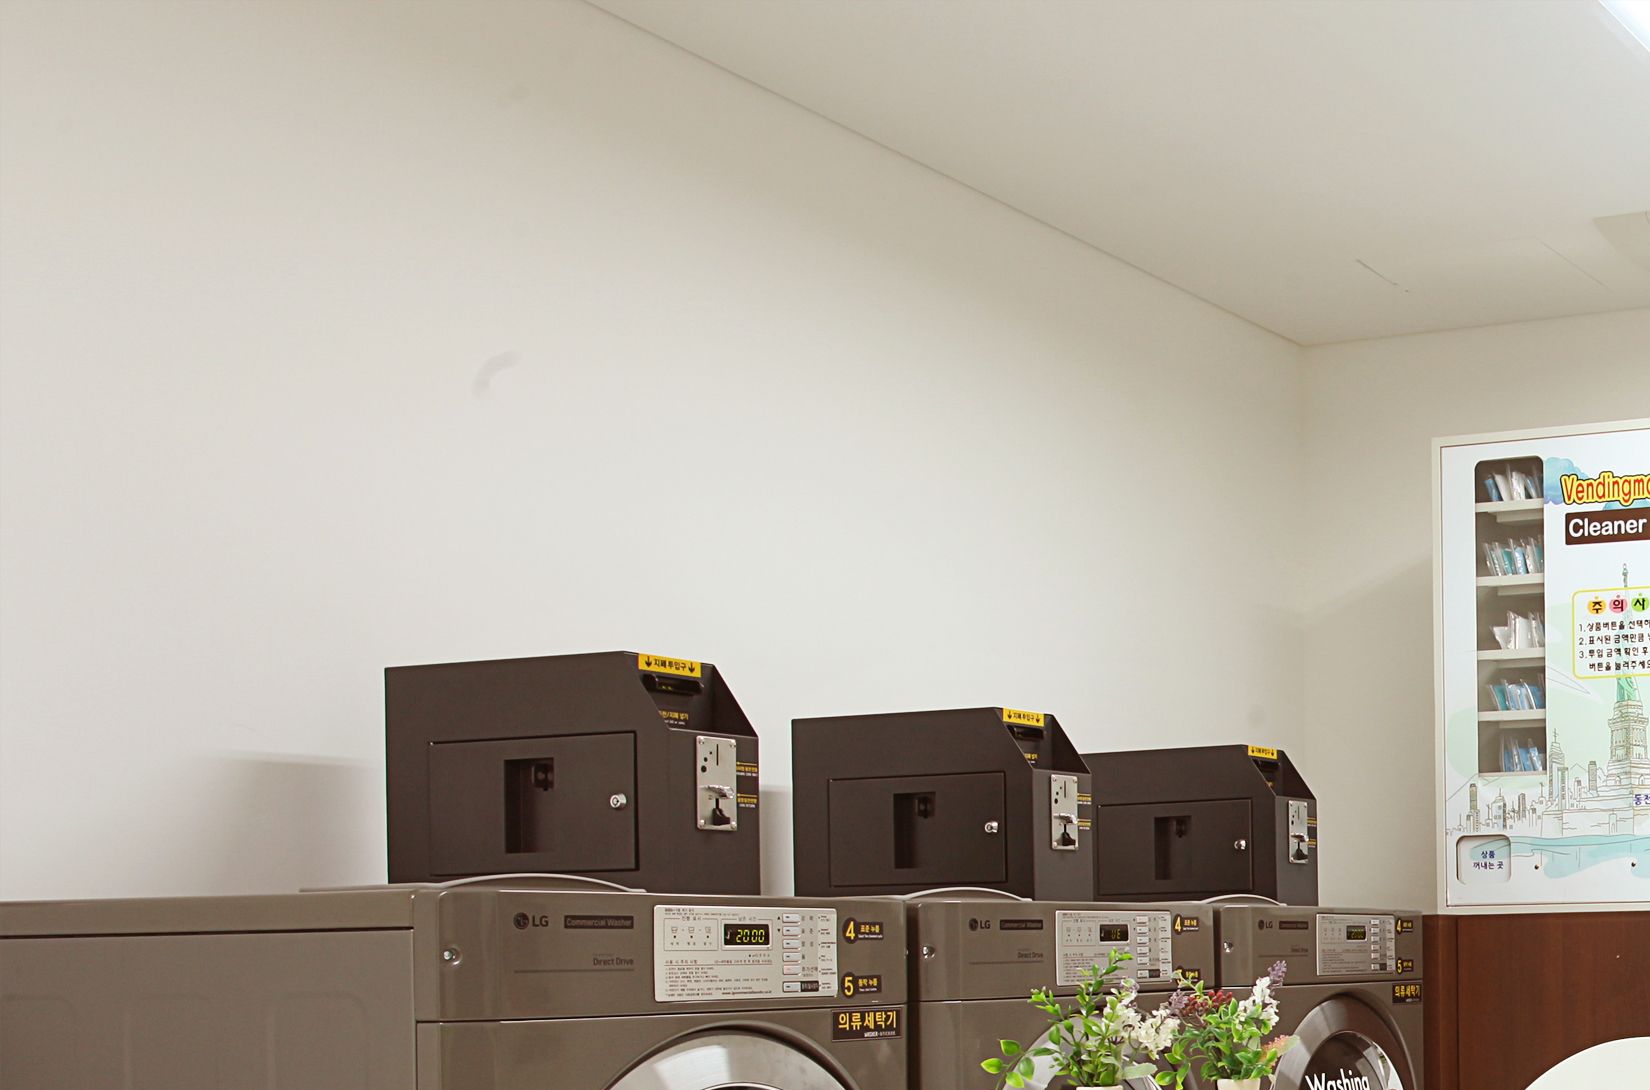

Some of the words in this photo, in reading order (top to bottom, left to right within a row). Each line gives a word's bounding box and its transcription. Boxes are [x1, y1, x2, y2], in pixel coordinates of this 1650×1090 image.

[1569, 518, 1647, 537] Cleaner
[1497, 861, 1503, 869] 곳
[532, 915, 549, 927] LG
[980, 920, 990, 929] LG
[1175, 916, 1181, 931] 4
[1397, 919, 1401, 933] 4
[846, 921, 855, 940] 4
[593, 957, 614, 966] Direct
[616, 957, 634, 965] Drive
[1397, 959, 1402, 973] 5
[845, 977, 853, 996] 5
